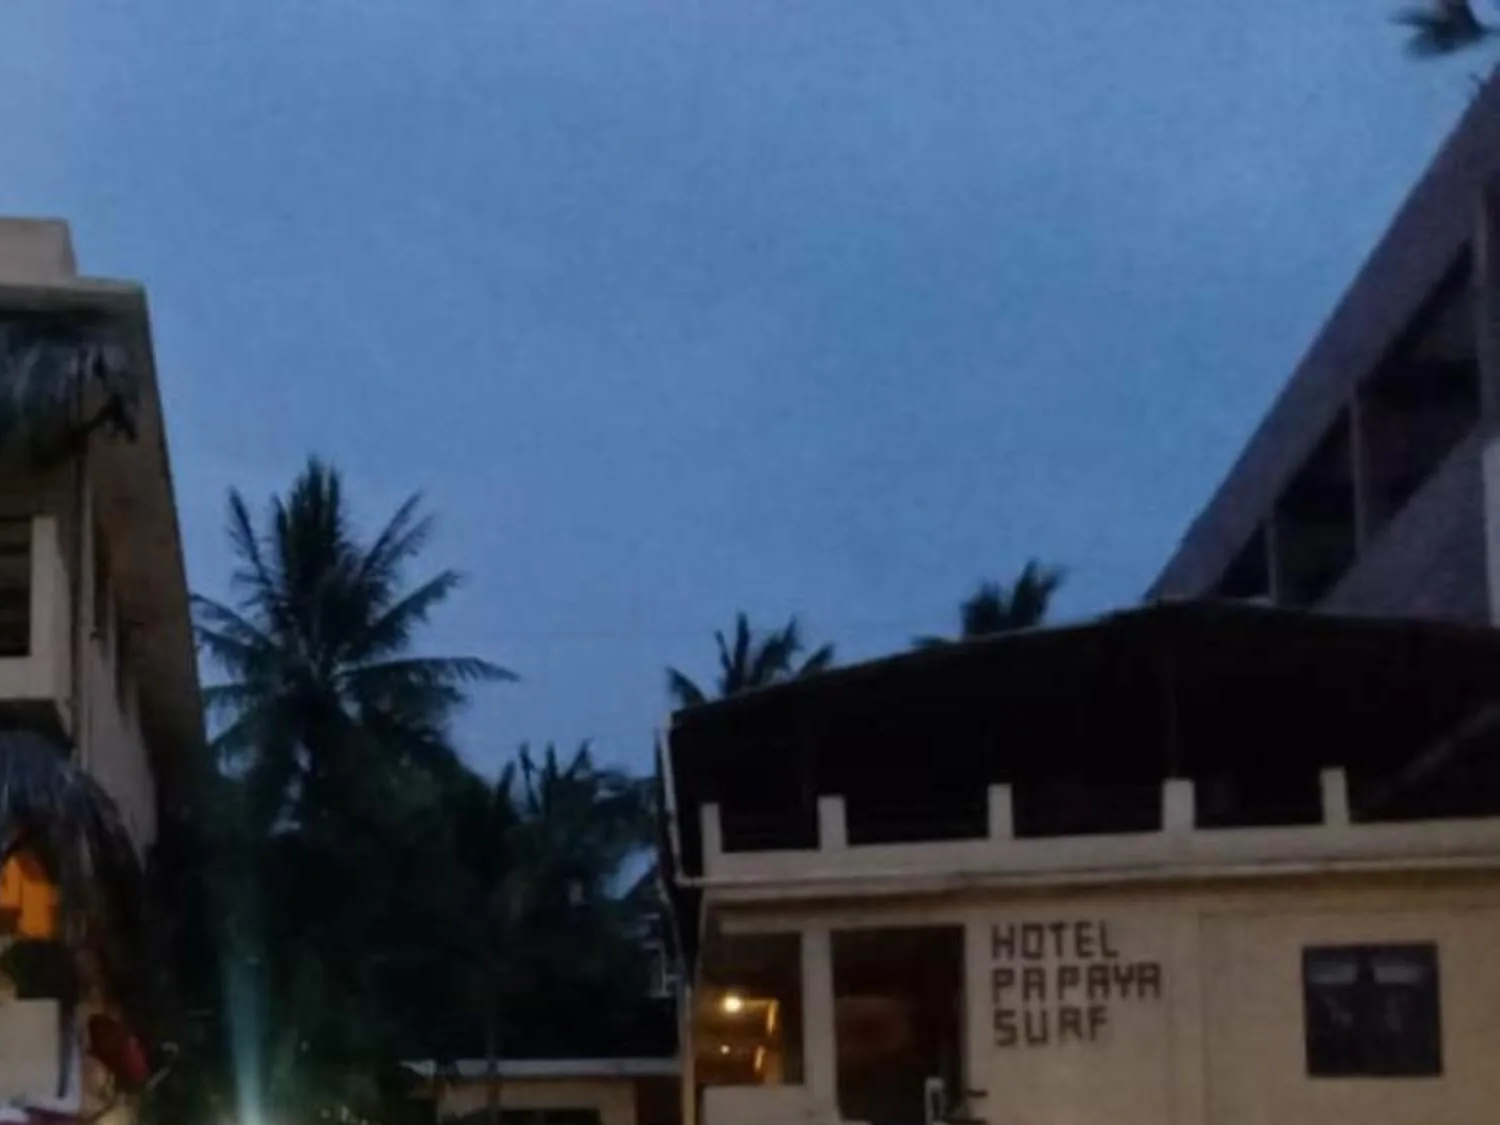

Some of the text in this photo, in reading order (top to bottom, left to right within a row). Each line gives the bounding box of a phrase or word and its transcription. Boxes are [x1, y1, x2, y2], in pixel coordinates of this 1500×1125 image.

[991, 921, 1120, 960] HOTEL
[991, 963, 1161, 1004] PAPAYA
[992, 1005, 1108, 1048] SURF
